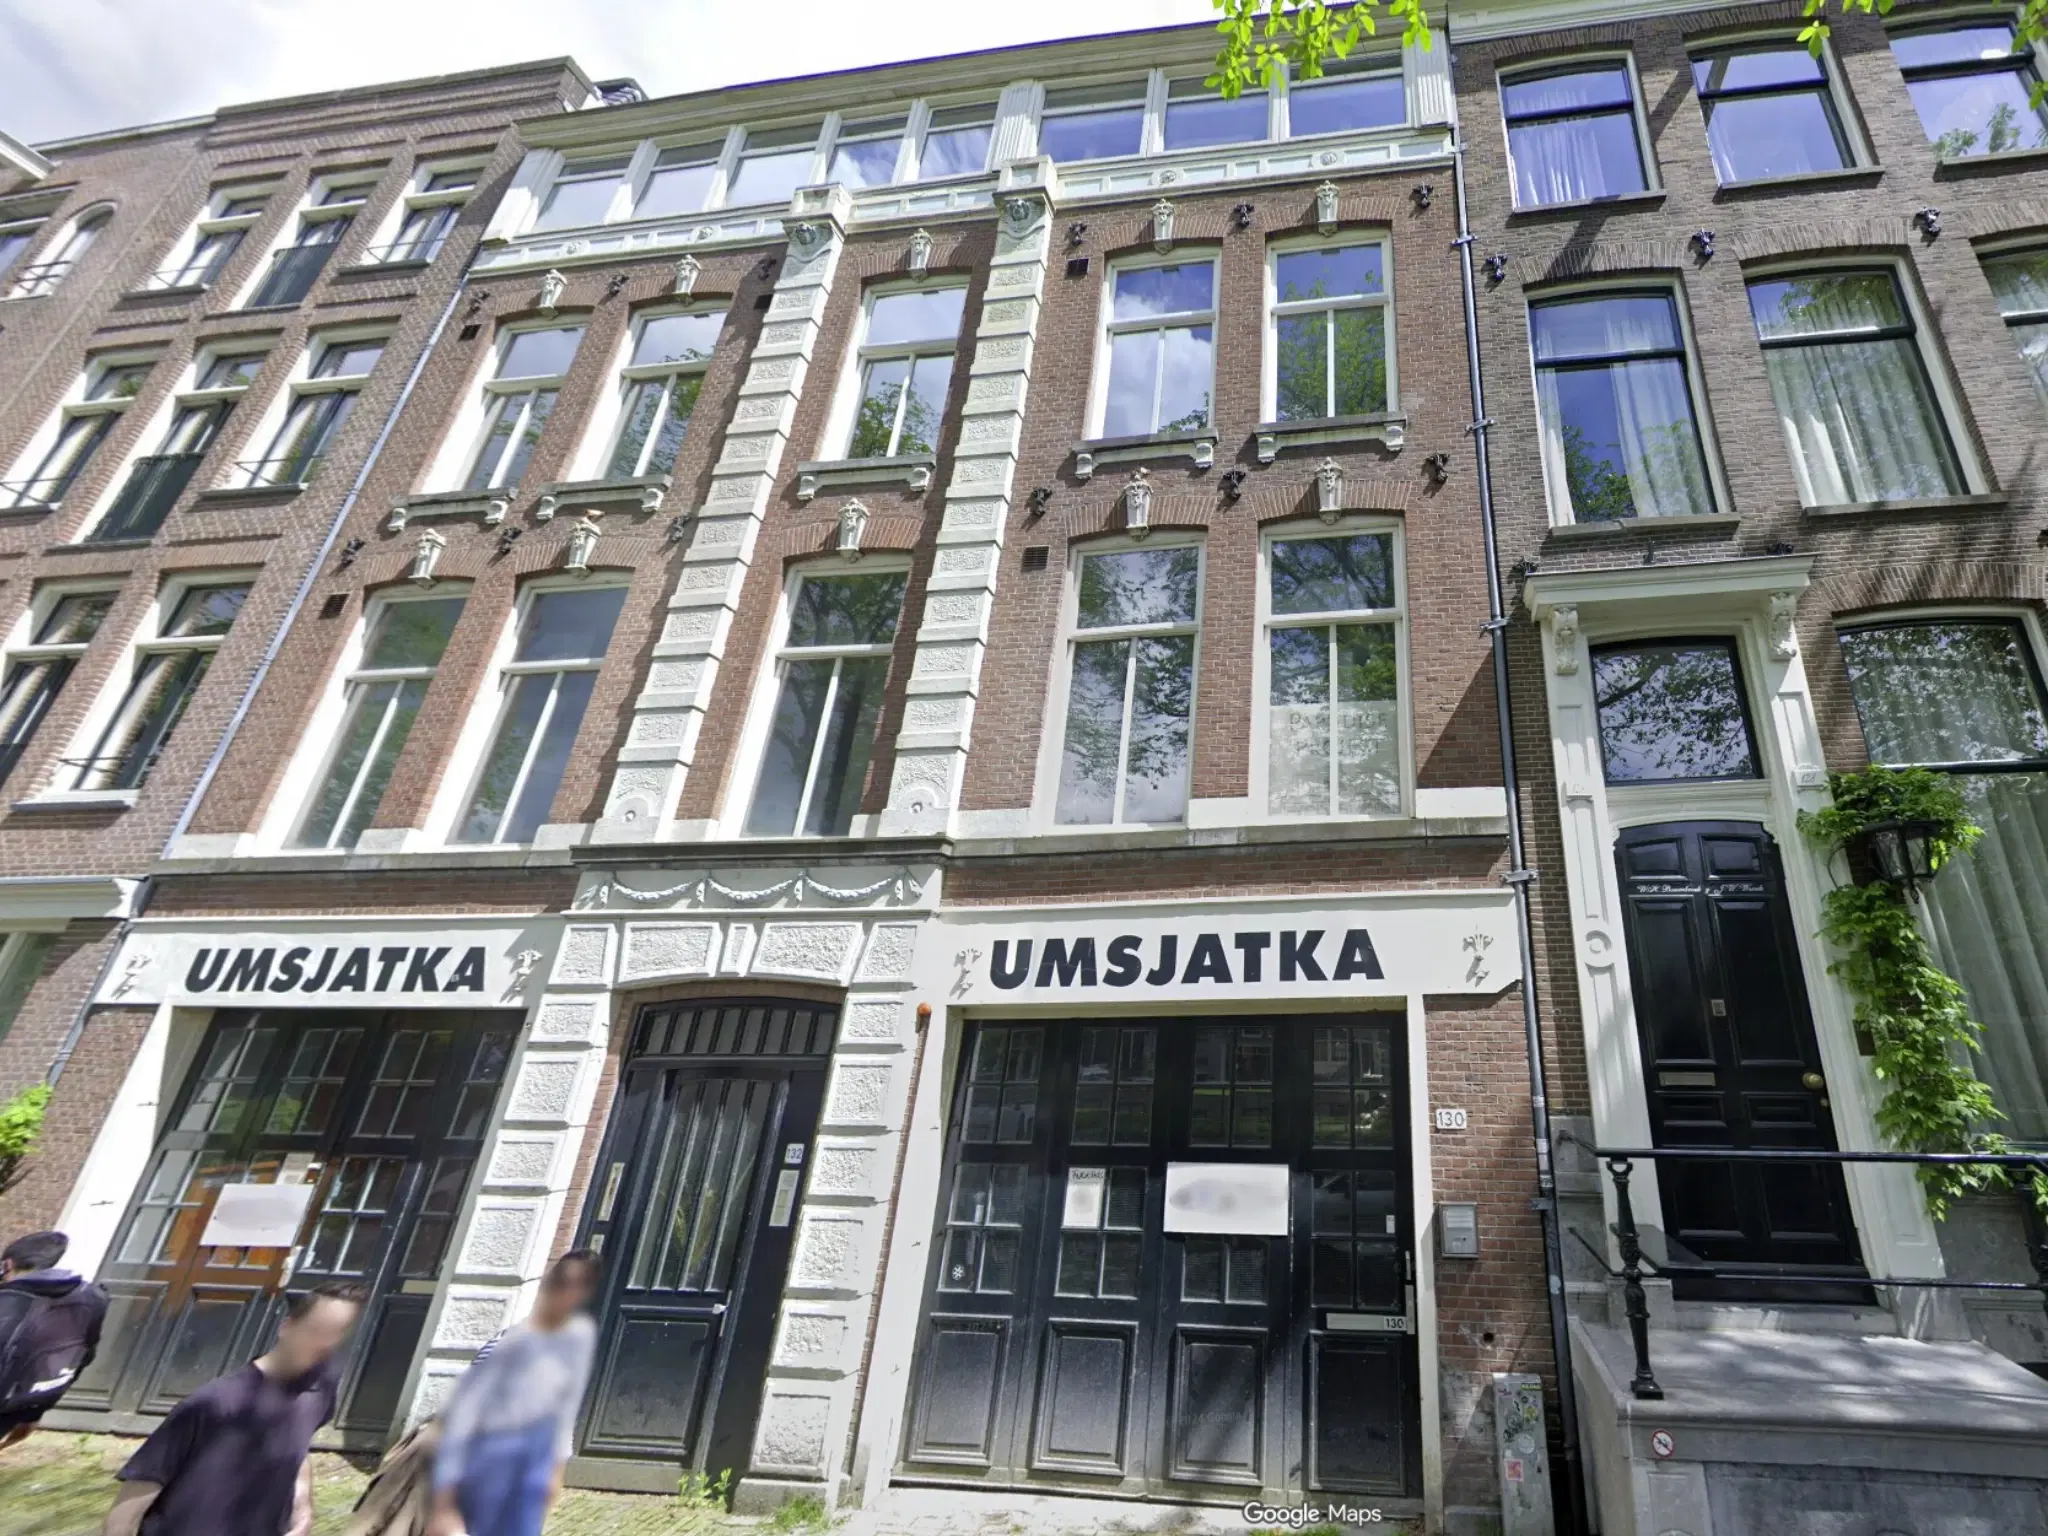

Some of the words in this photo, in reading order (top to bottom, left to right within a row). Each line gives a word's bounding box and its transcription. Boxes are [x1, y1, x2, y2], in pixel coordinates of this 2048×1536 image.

[989, 928, 1385, 990] UMSJATKA
[184, 946, 487, 993] UMSJATKA
[1438, 1111, 1465, 1127] 130
[786, 1148, 803, 1160] 132
[1385, 1318, 1405, 1329] 130
